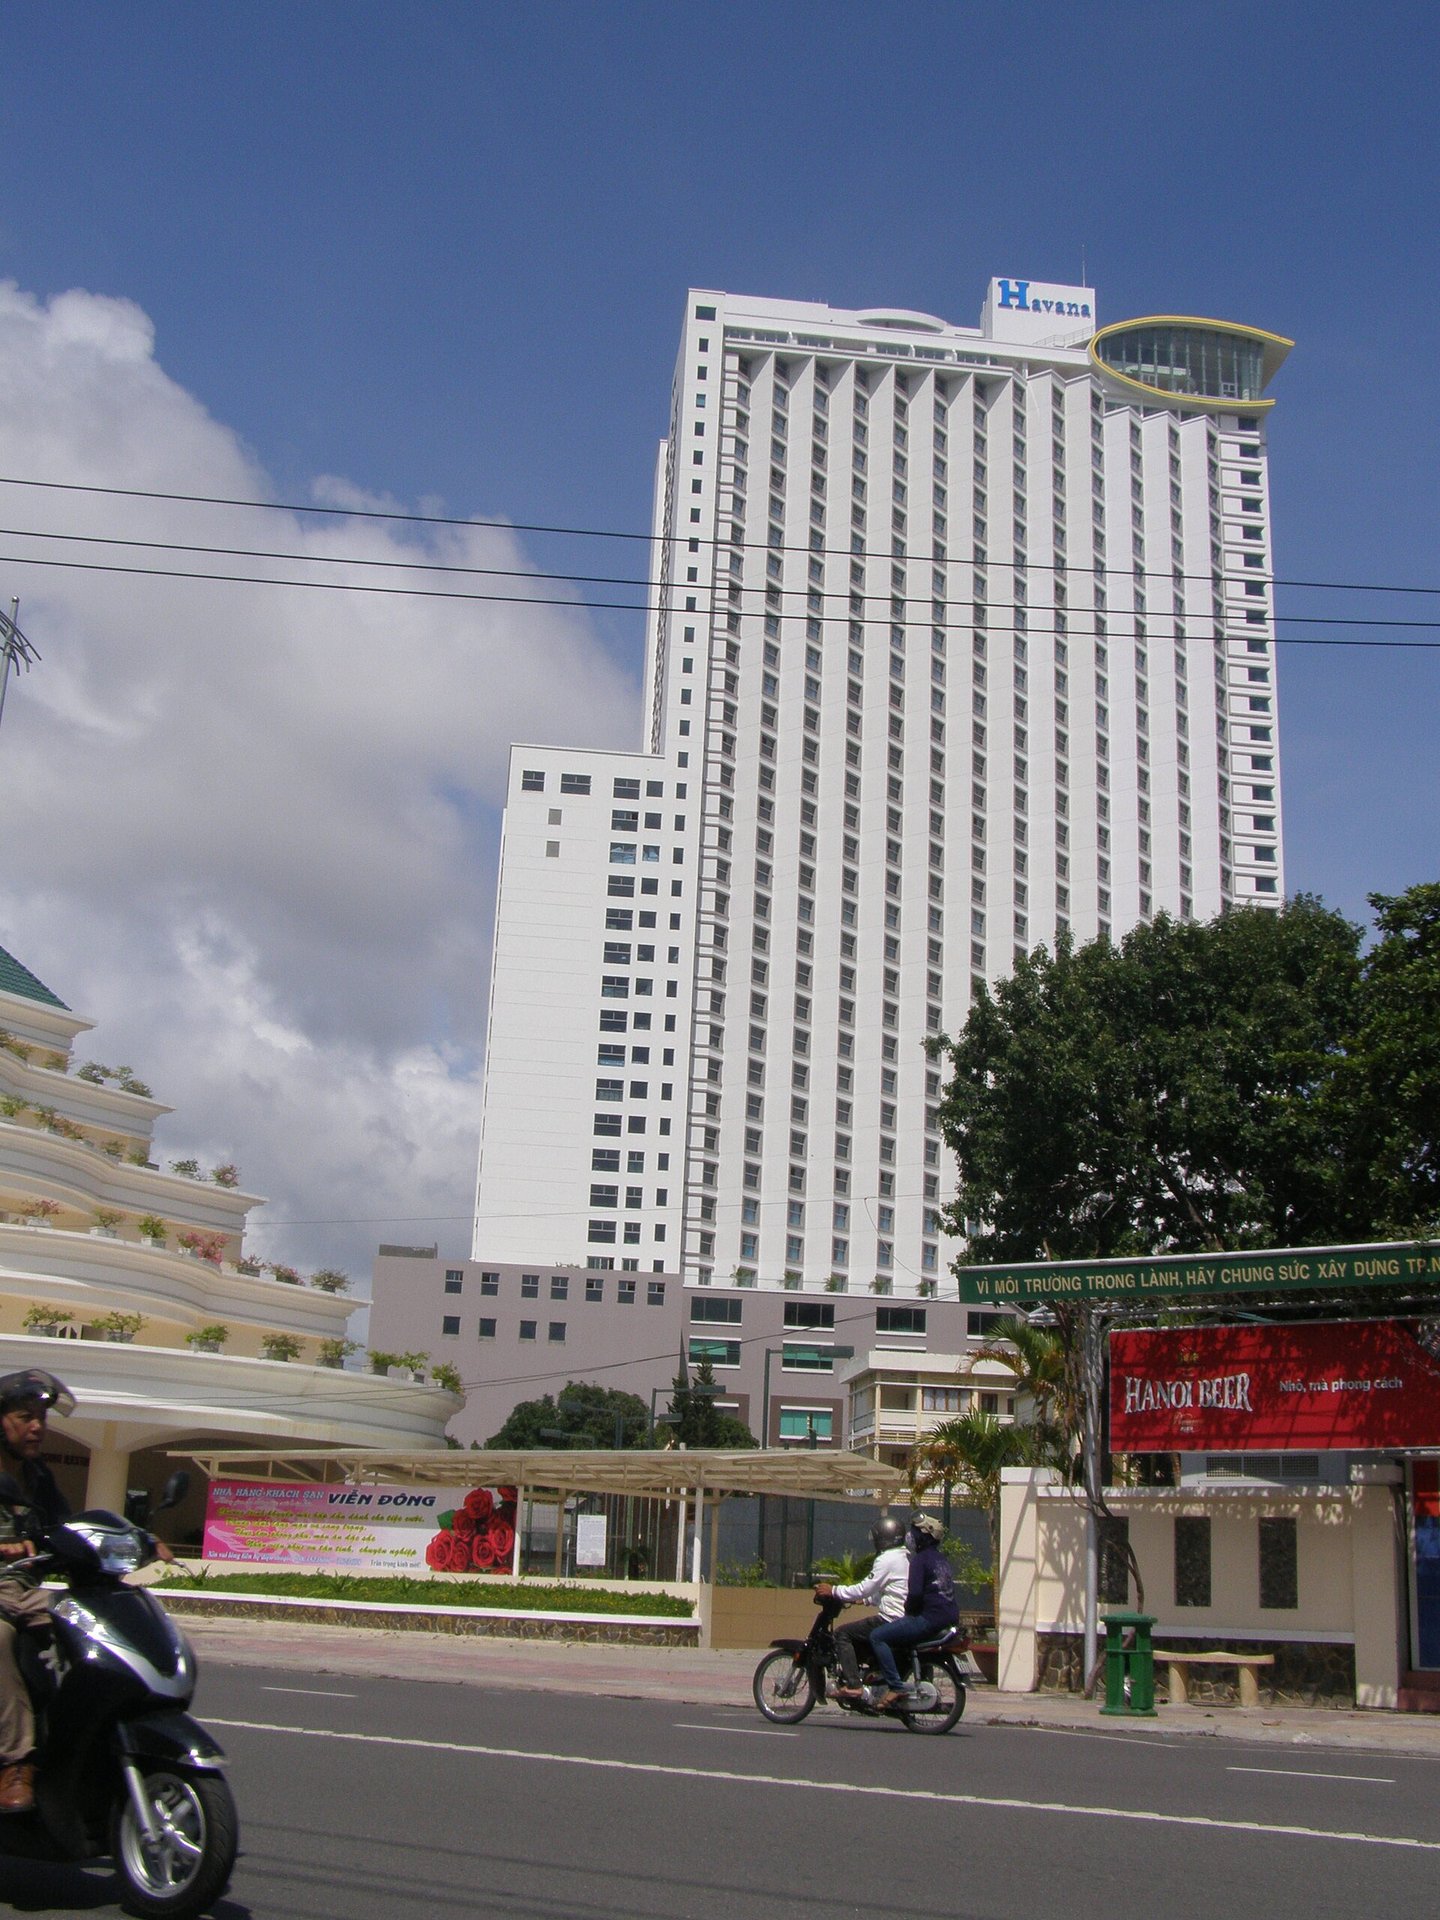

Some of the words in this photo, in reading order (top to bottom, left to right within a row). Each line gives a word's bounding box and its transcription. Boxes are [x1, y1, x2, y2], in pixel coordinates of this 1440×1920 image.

[998, 280, 1091, 318] Havana
[976, 1277, 989, 1294] VÌ
[995, 1276, 1019, 1294] MÔI
[1024, 1273, 1081, 1292] TRƯỜNG
[1086, 1274, 1135, 1290] TRONG
[1140, 1269, 1183, 1288] LÀNH,
[1186, 1266, 1216, 1285] HÃY
[1221, 1266, 1275, 1284] CHUNG
[1279, 1260, 1310, 1280] SỨC
[1318, 1259, 1347, 1279] XÂY
[1354, 1258, 1400, 1280] DỰNG
[1124, 1375, 1193, 1414] HANOI
[1198, 1372, 1253, 1412] BEER
[1309, 1378, 1329, 1391] mà
[1331, 1378, 1371, 1393] phong
[1374, 1376, 1403, 1389] cách
[328, 1489, 374, 1505] VIỄN
[377, 1493, 437, 1507] ĐÔNG
